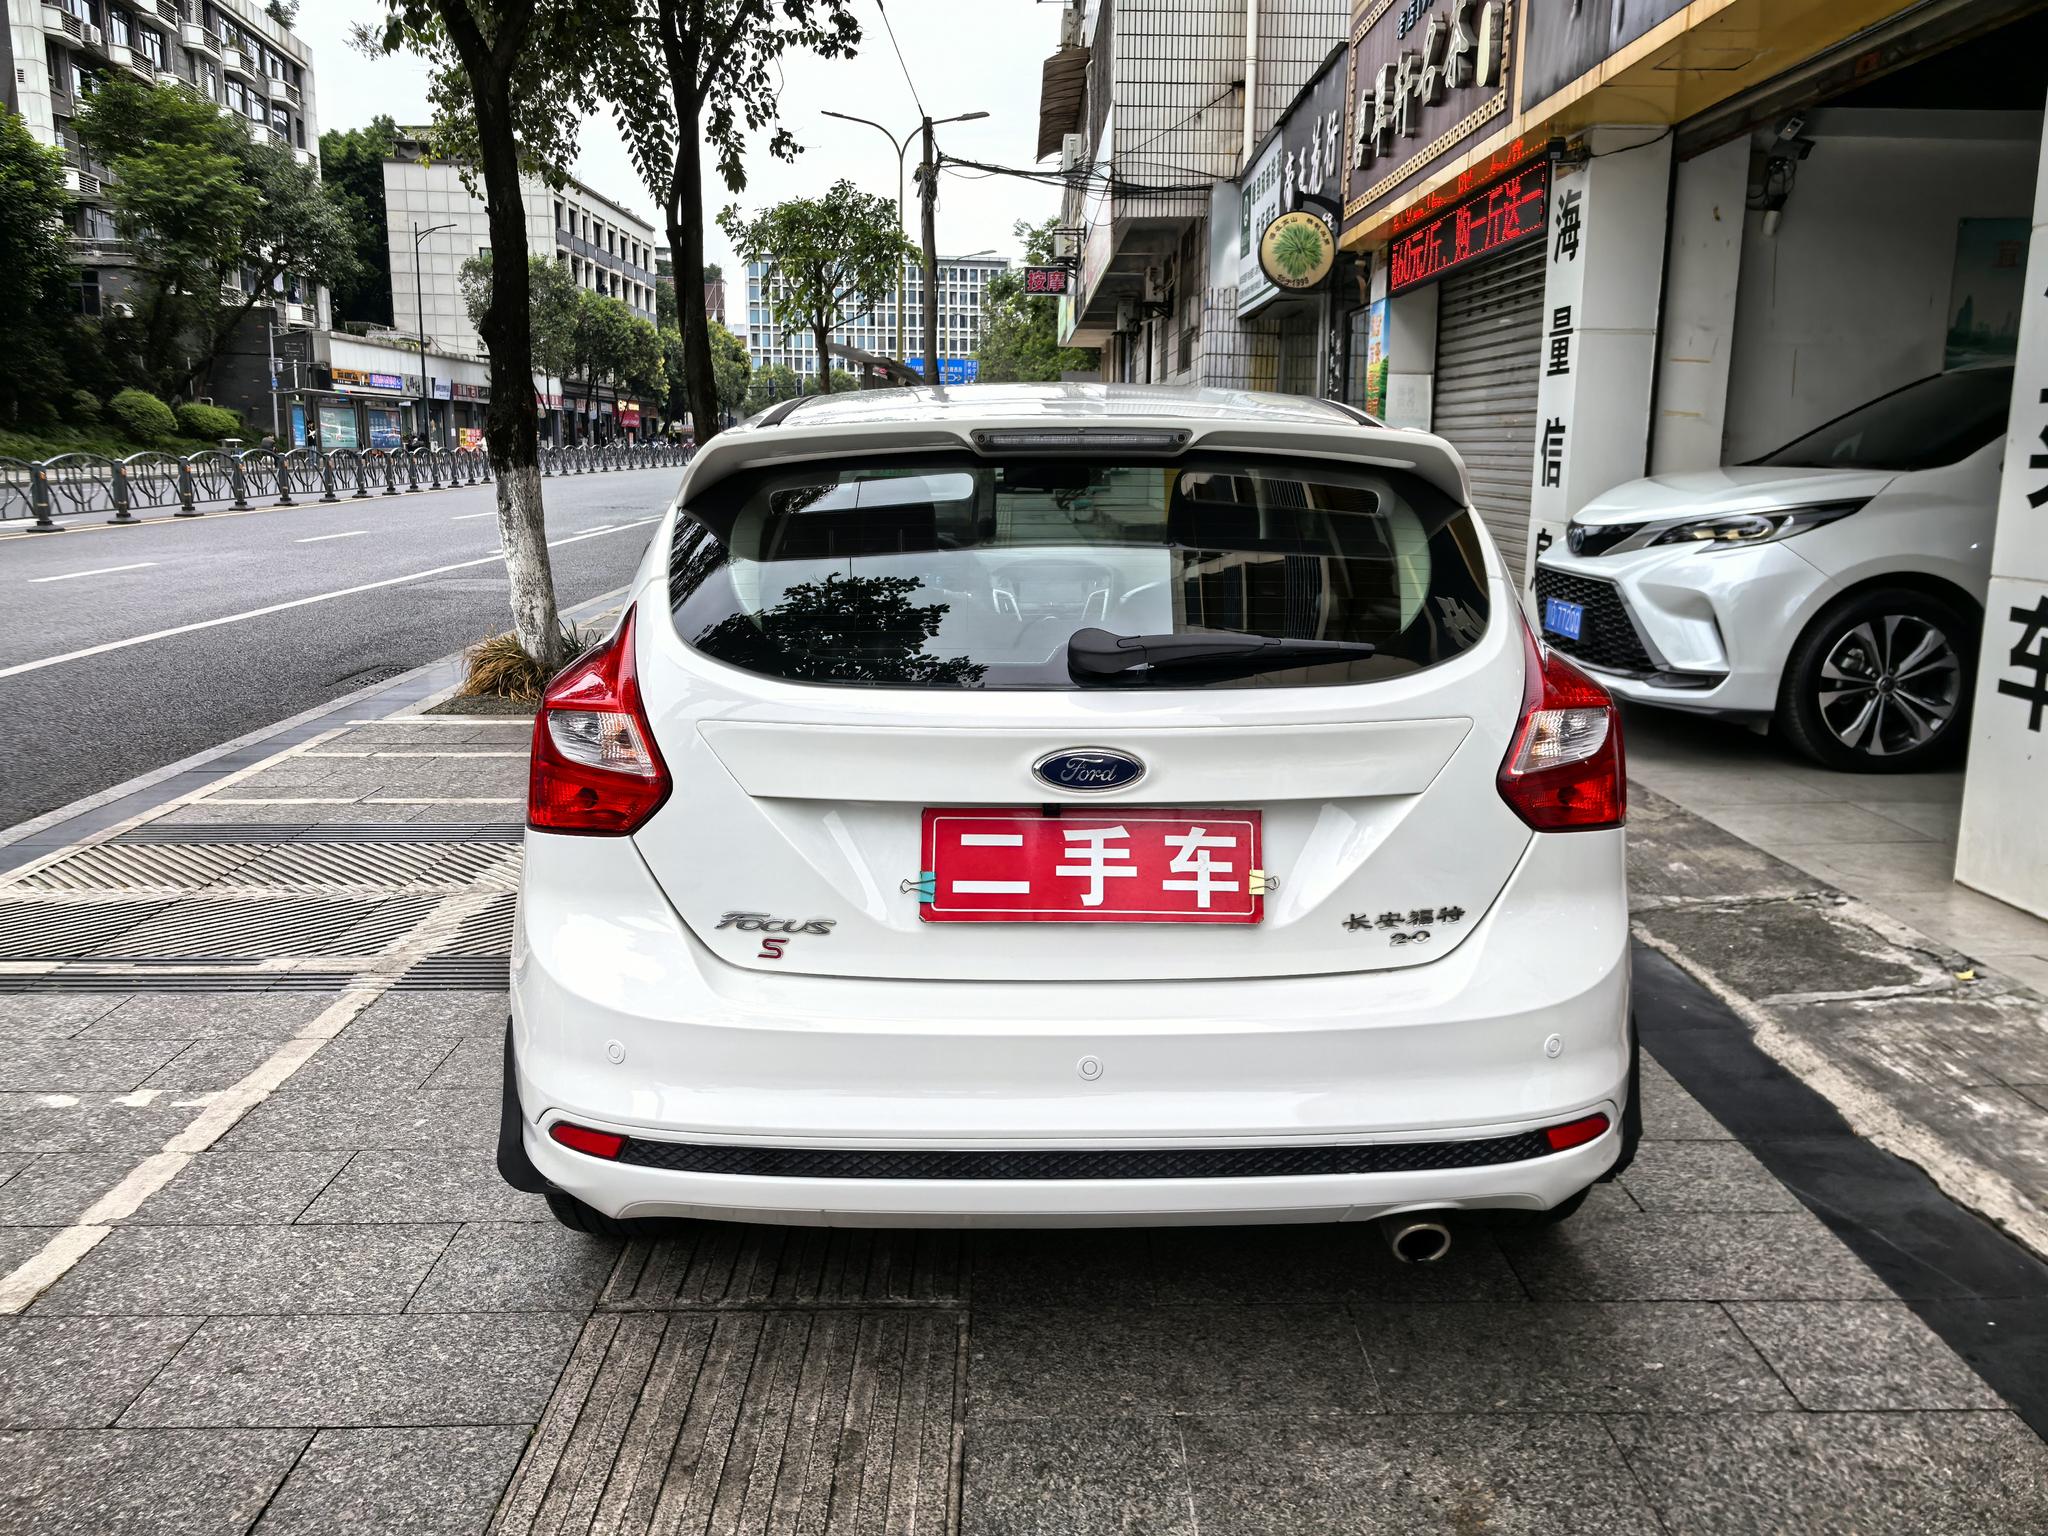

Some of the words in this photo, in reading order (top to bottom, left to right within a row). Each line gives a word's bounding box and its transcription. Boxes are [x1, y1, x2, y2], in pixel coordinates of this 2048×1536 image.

[1028, 270, 1066, 291] 按摩
[1060, 757, 1117, 781] Ford
[952, 825, 1239, 908] 二手车
[1341, 906, 1466, 933] 长安福特
[757, 937, 790, 960] S
